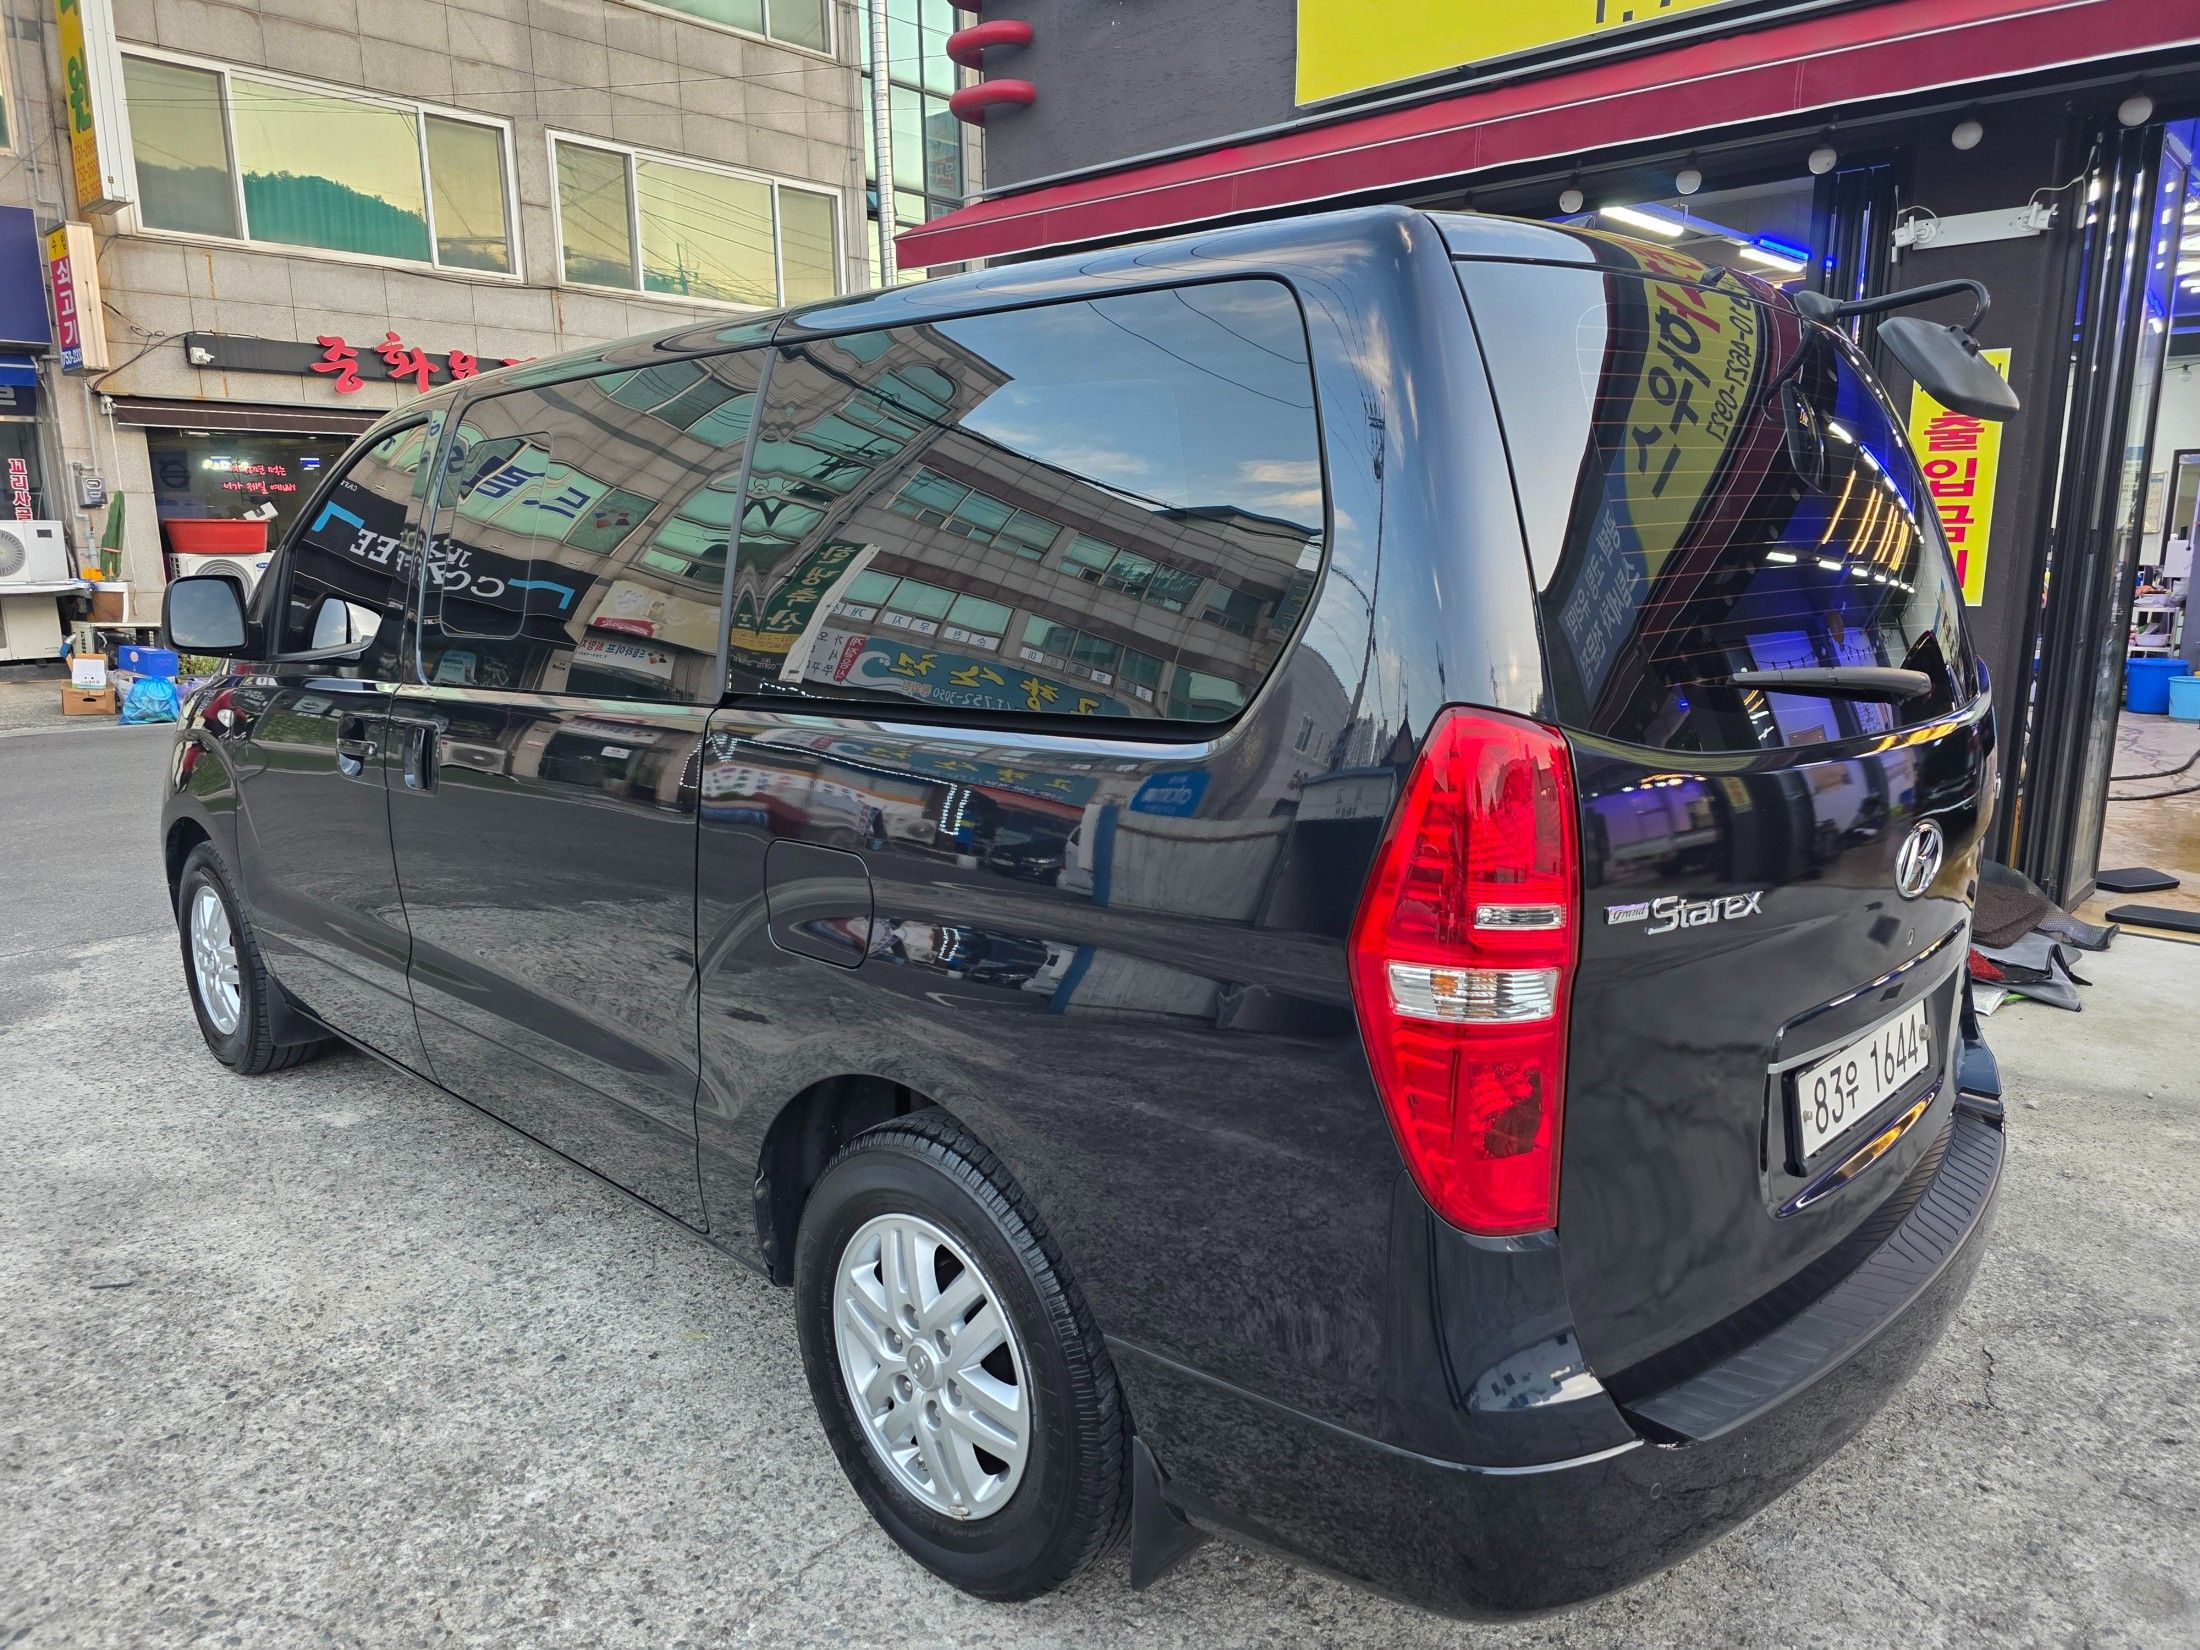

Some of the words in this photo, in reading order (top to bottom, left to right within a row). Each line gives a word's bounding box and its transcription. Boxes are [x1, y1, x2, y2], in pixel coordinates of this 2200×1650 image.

[56, 258, 79, 345] 쇠고기
[1647, 890, 1764, 936] Starex
[1814, 1060, 1860, 1135] 83우
[1870, 1013, 1919, 1094] 1644
